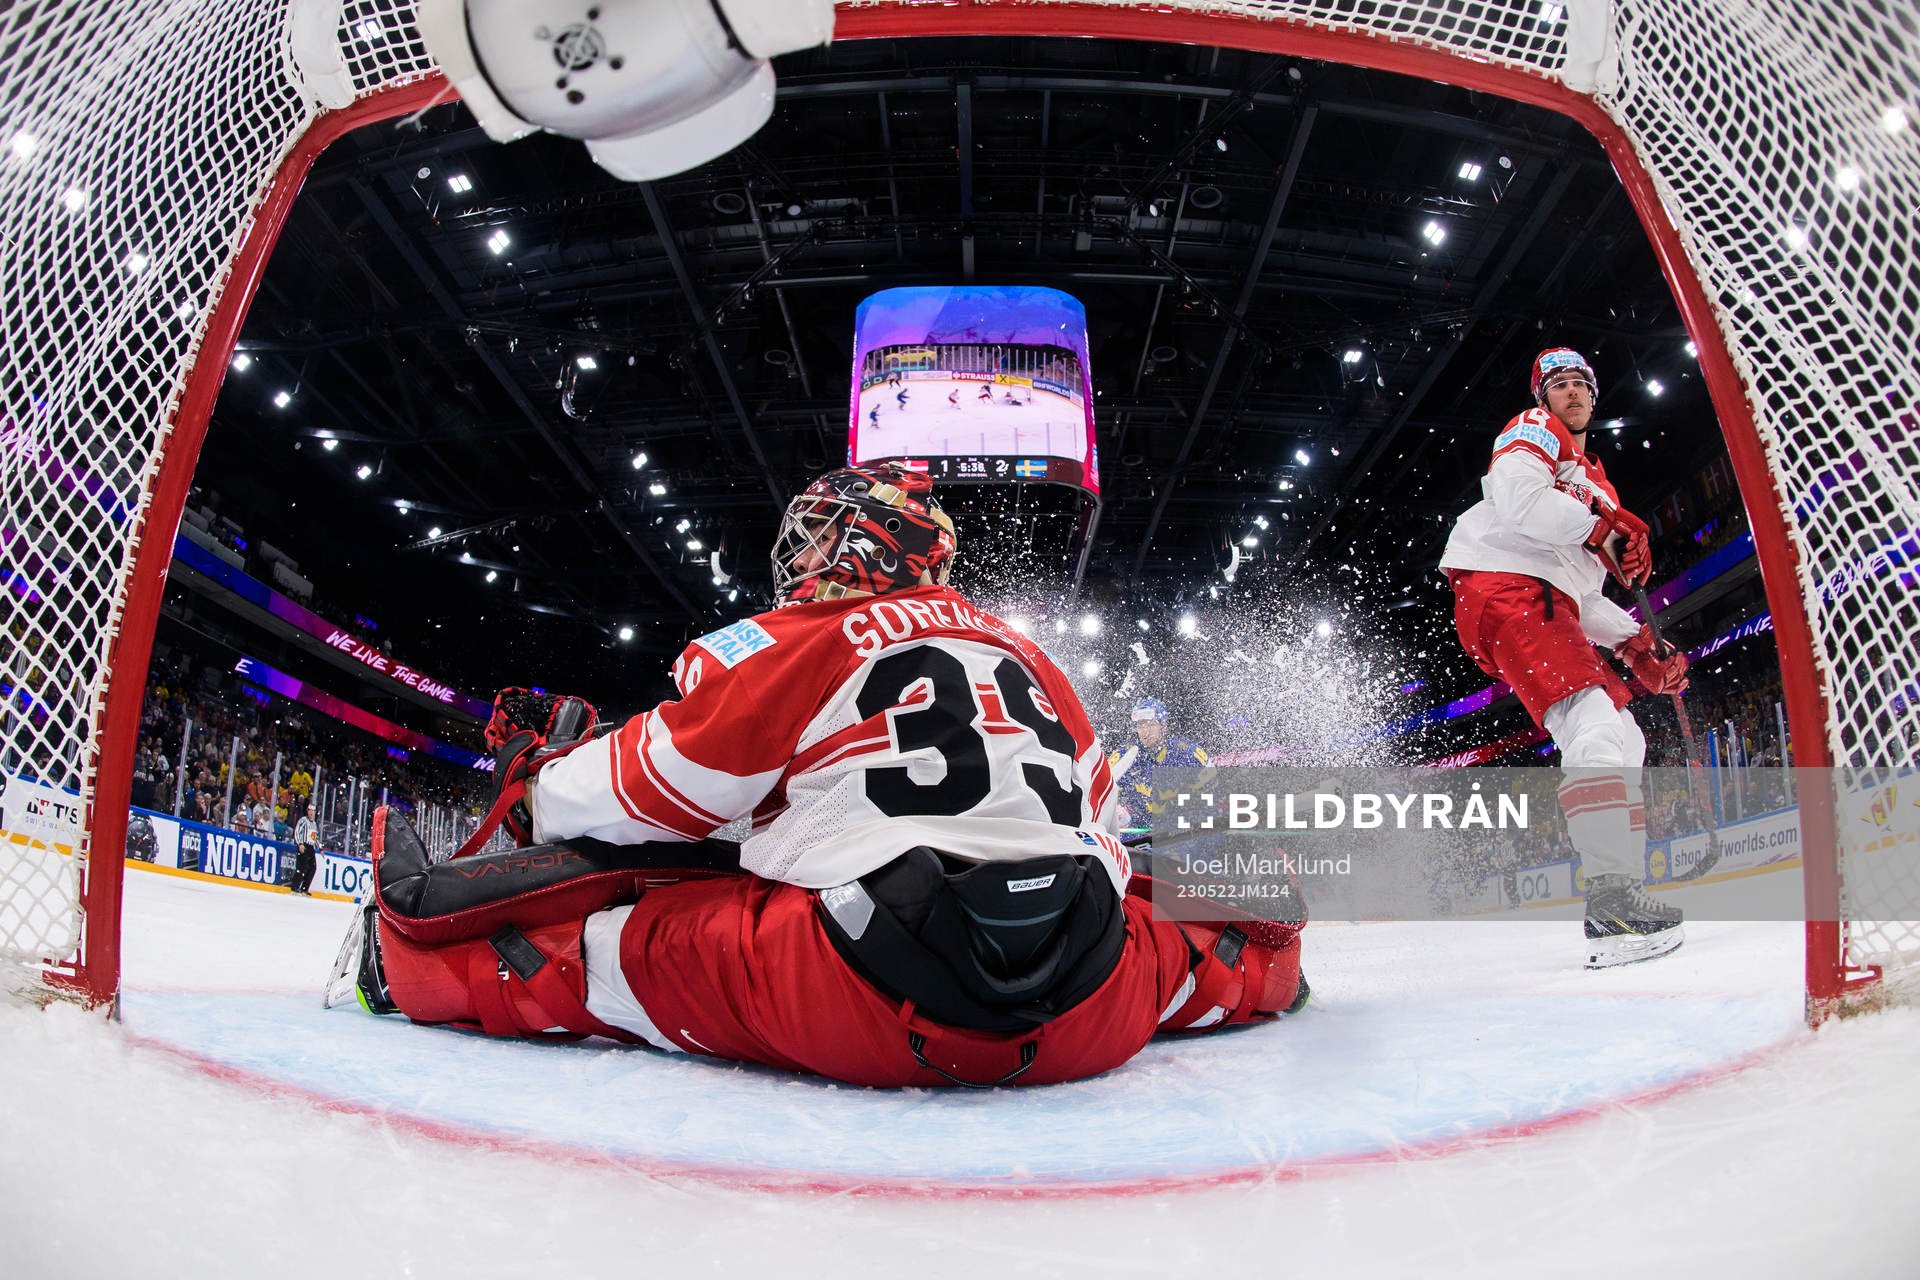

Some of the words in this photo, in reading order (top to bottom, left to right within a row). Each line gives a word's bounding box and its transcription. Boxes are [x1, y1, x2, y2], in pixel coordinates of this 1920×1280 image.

[960, 372, 995, 381] STRAUSS
[1519, 431, 1557, 457] METAL
[1521, 424, 1558, 448] DANSK
[941, 460, 948, 472] 1
[996, 460, 1006, 472] 2
[703, 632, 744, 663] ETAL
[726, 621, 769, 651] NSK
[234, 658, 253, 675] E
[326, 631, 357, 652] WE
[352, 645, 388, 671] LIVE
[391, 664, 418, 686] THE
[417, 678, 455, 703] GAME
[855, 644, 1083, 829] 39
[204, 832, 278, 884] NOCCO
[452, 850, 592, 880] VAPOR
[1010, 878, 1051, 890] BAUER
